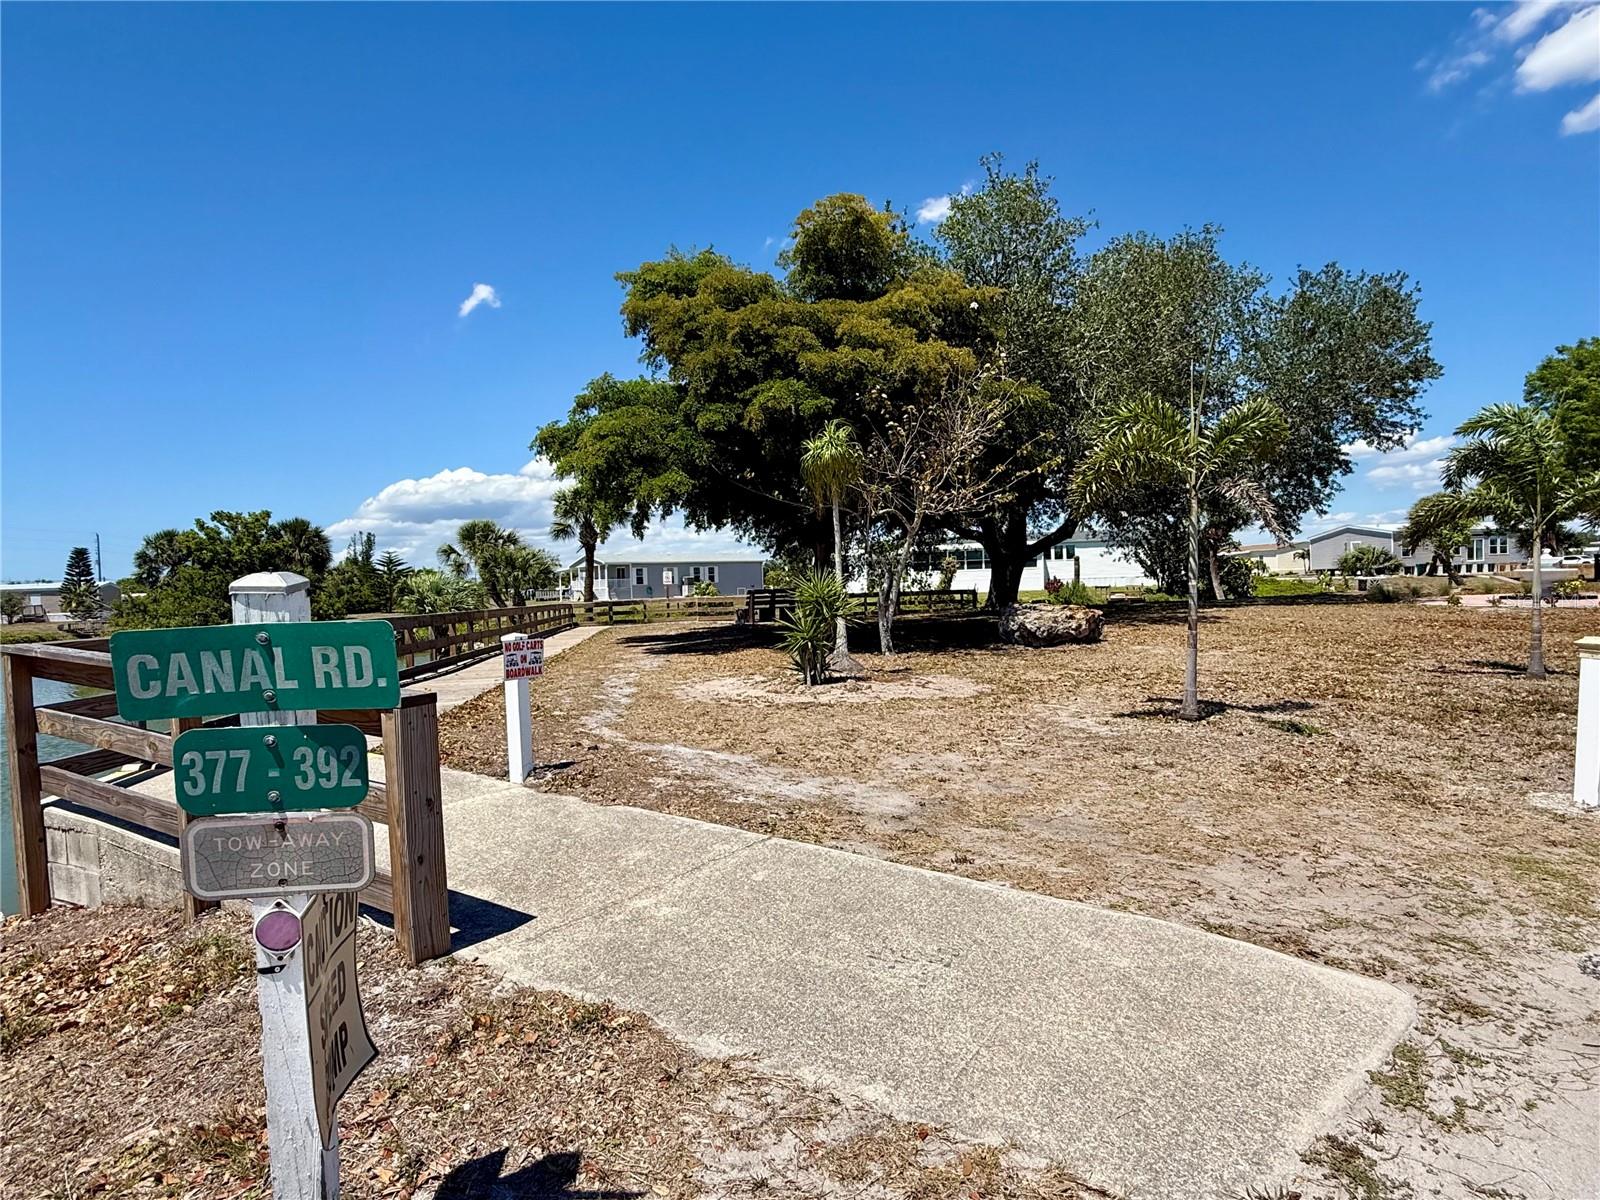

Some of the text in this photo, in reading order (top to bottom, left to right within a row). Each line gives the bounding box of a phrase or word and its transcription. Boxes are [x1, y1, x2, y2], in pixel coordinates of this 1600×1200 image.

[504, 640, 544, 652] NO GOLF CARTS
[520, 654, 528, 664] ON
[126, 645, 388, 700] CANAL RD.
[505, 665, 543, 679] BOARDWALK
[181, 750, 251, 797] 377
[292, 745, 363, 791] 392
[250, 860, 316, 879] ZONE
